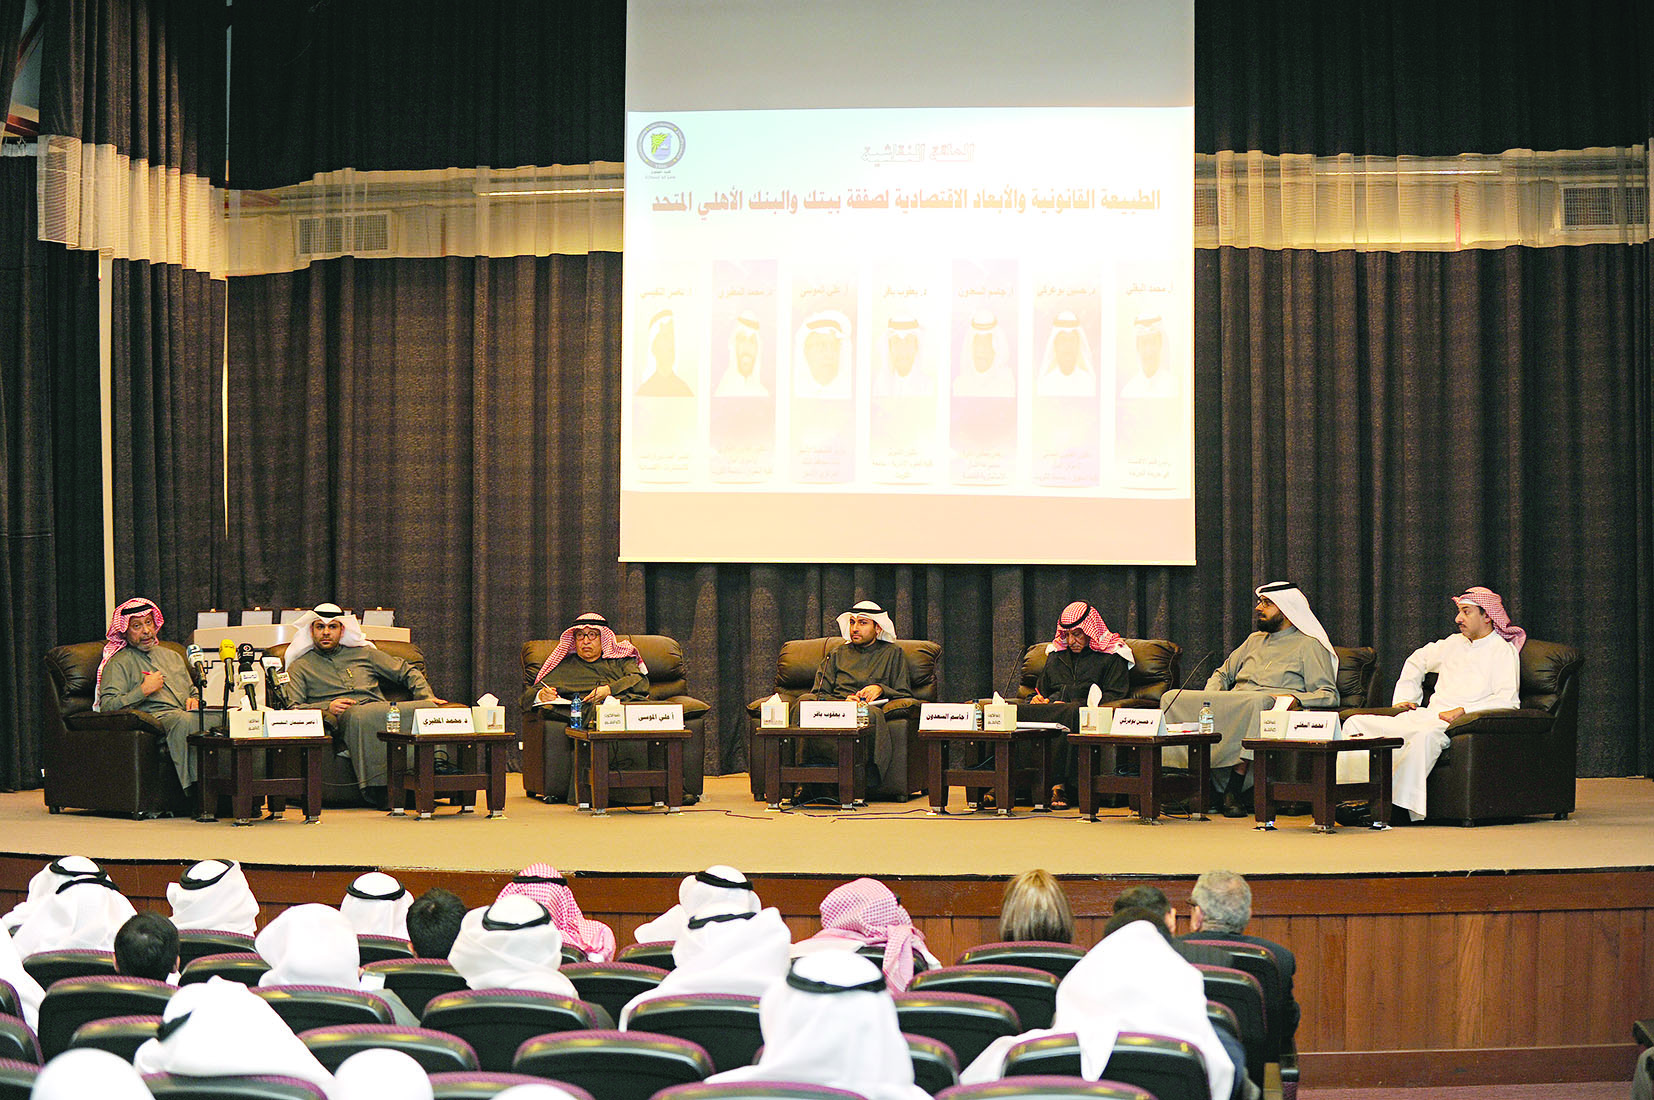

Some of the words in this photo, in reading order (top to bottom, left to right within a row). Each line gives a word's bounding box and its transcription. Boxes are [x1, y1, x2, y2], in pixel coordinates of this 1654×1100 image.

[861, 143, 926, 168] النقاشية
[652, 190, 693, 211] المتحد
[697, 185, 743, 221] الأهلي
[748, 189, 798, 215] والبنك
[803, 189, 841, 214] بيتك
[846, 188, 890, 209] لصفقة
[895, 188, 968, 214] الاقتصادية
[973, 184, 1026, 214] والأبعاد
[1031, 188, 1095, 214] القانونية
[1101, 188, 1160, 215] الطبيعة
[926, 713, 949, 721] السعدون
[950, 713, 965, 721] جاسم
[1311, 721, 1324, 729] محمد
